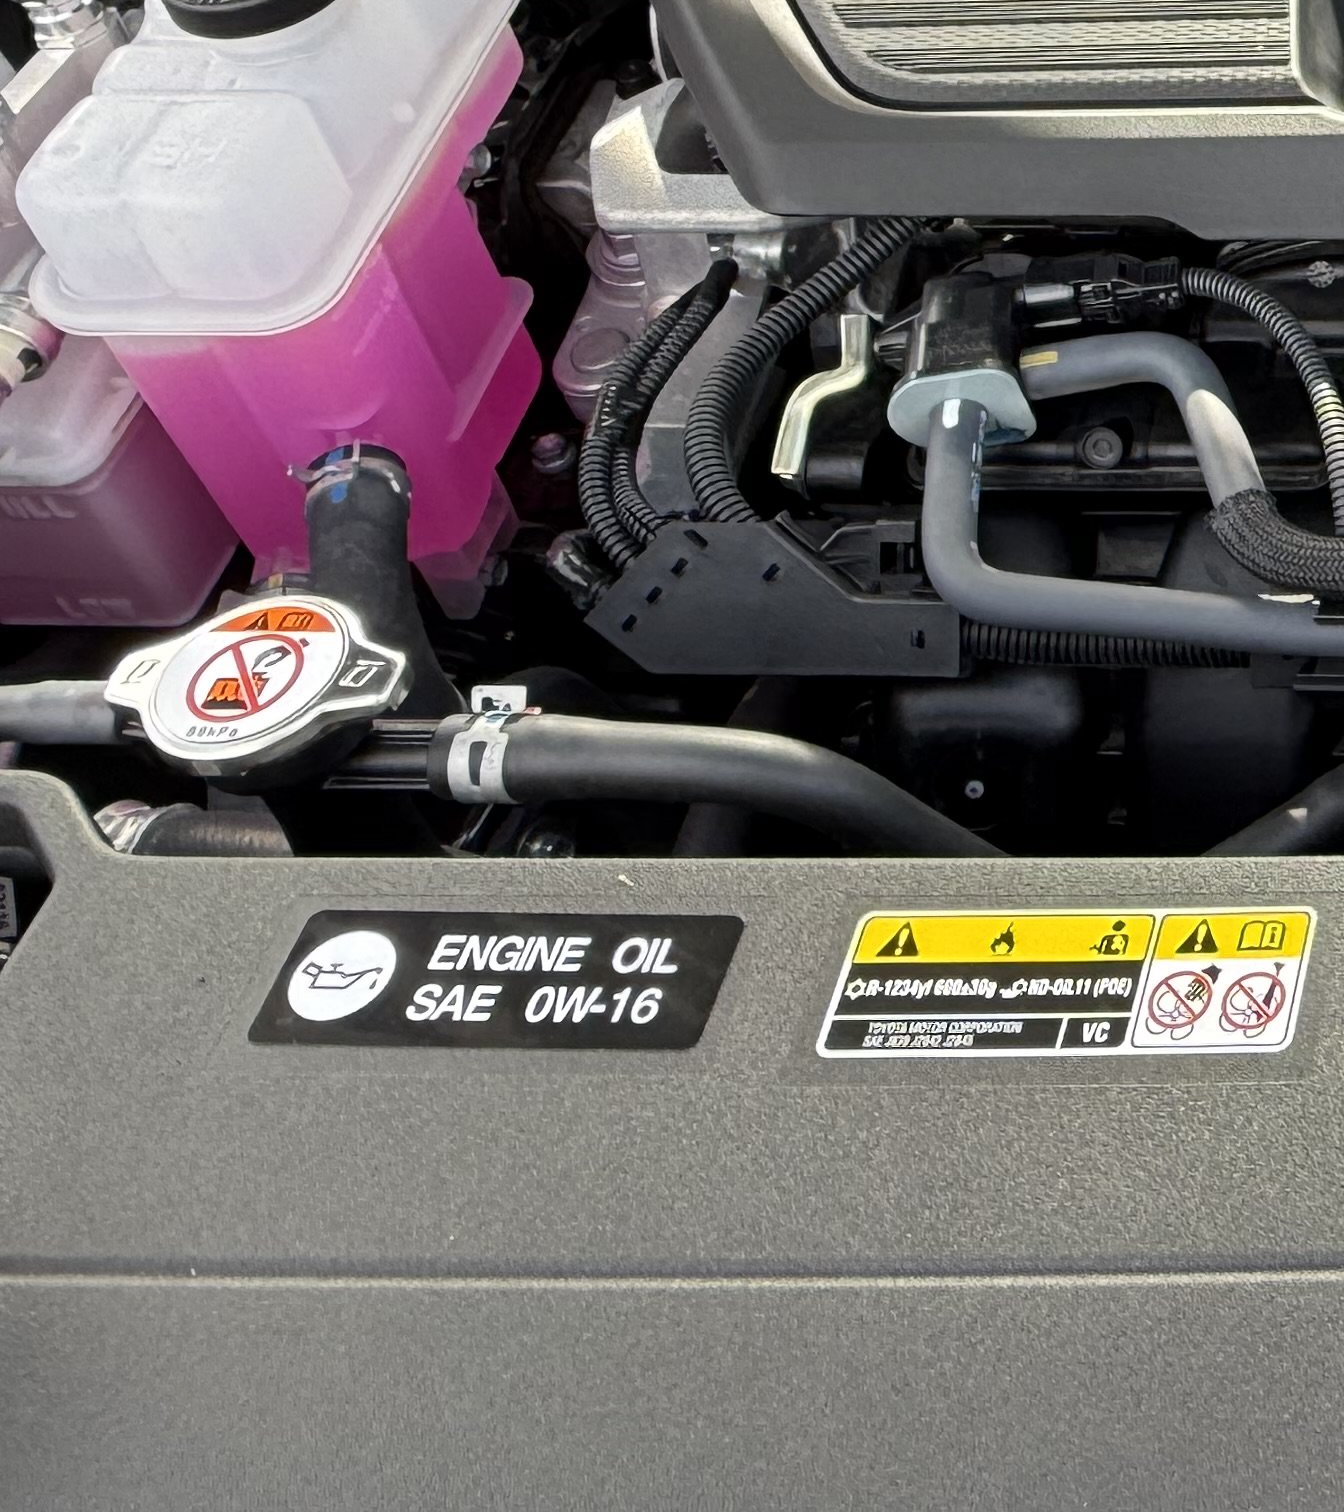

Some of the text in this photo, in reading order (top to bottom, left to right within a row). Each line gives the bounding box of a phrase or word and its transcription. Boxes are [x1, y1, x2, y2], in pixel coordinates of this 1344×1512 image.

[427, 934, 679, 975] ENGINE OIL
[405, 983, 664, 1025] SAE 0W-16
[1082, 1022, 1111, 1043] VC
